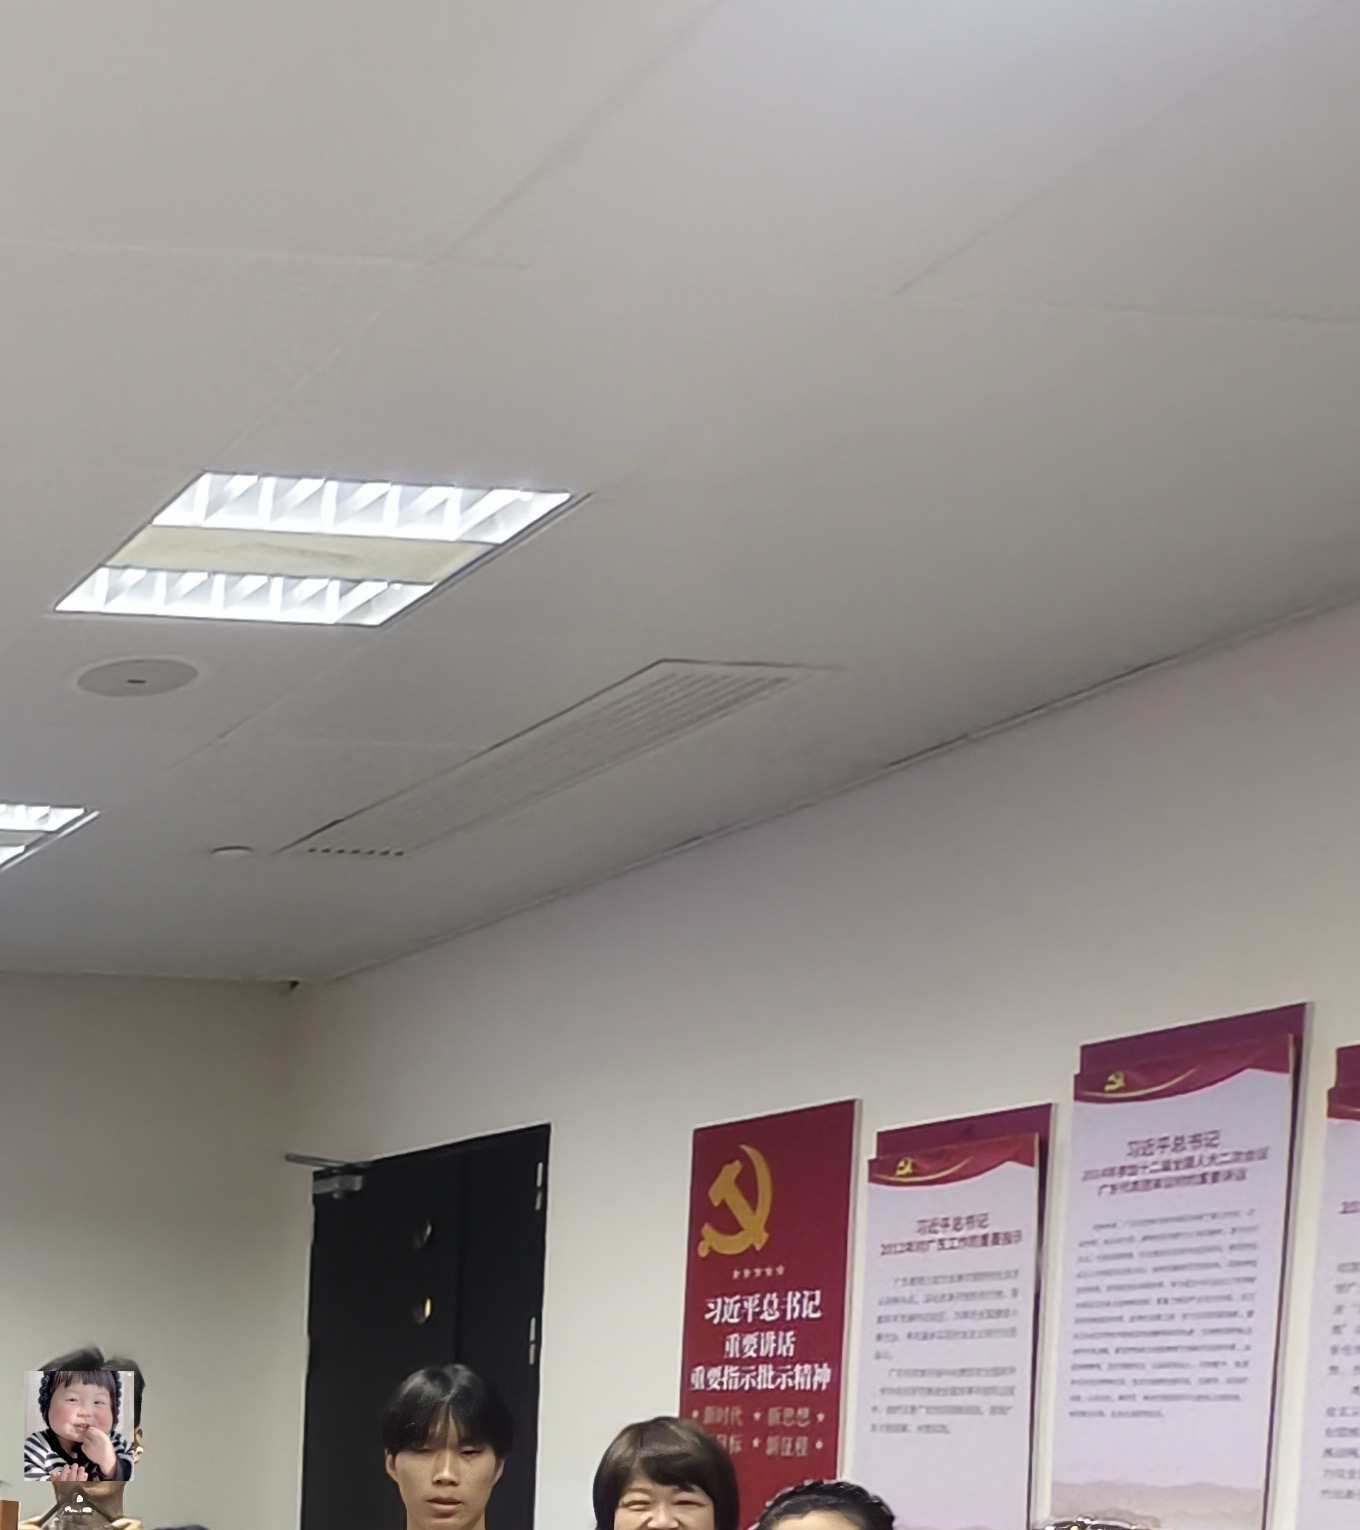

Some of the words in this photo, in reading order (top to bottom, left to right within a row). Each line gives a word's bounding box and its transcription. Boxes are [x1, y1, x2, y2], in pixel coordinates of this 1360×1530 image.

[704, 1289, 823, 1325] 习近平总书记
[724, 1330, 797, 1359] 重要讲话
[690, 1363, 832, 1392] 重要指示批示精神
